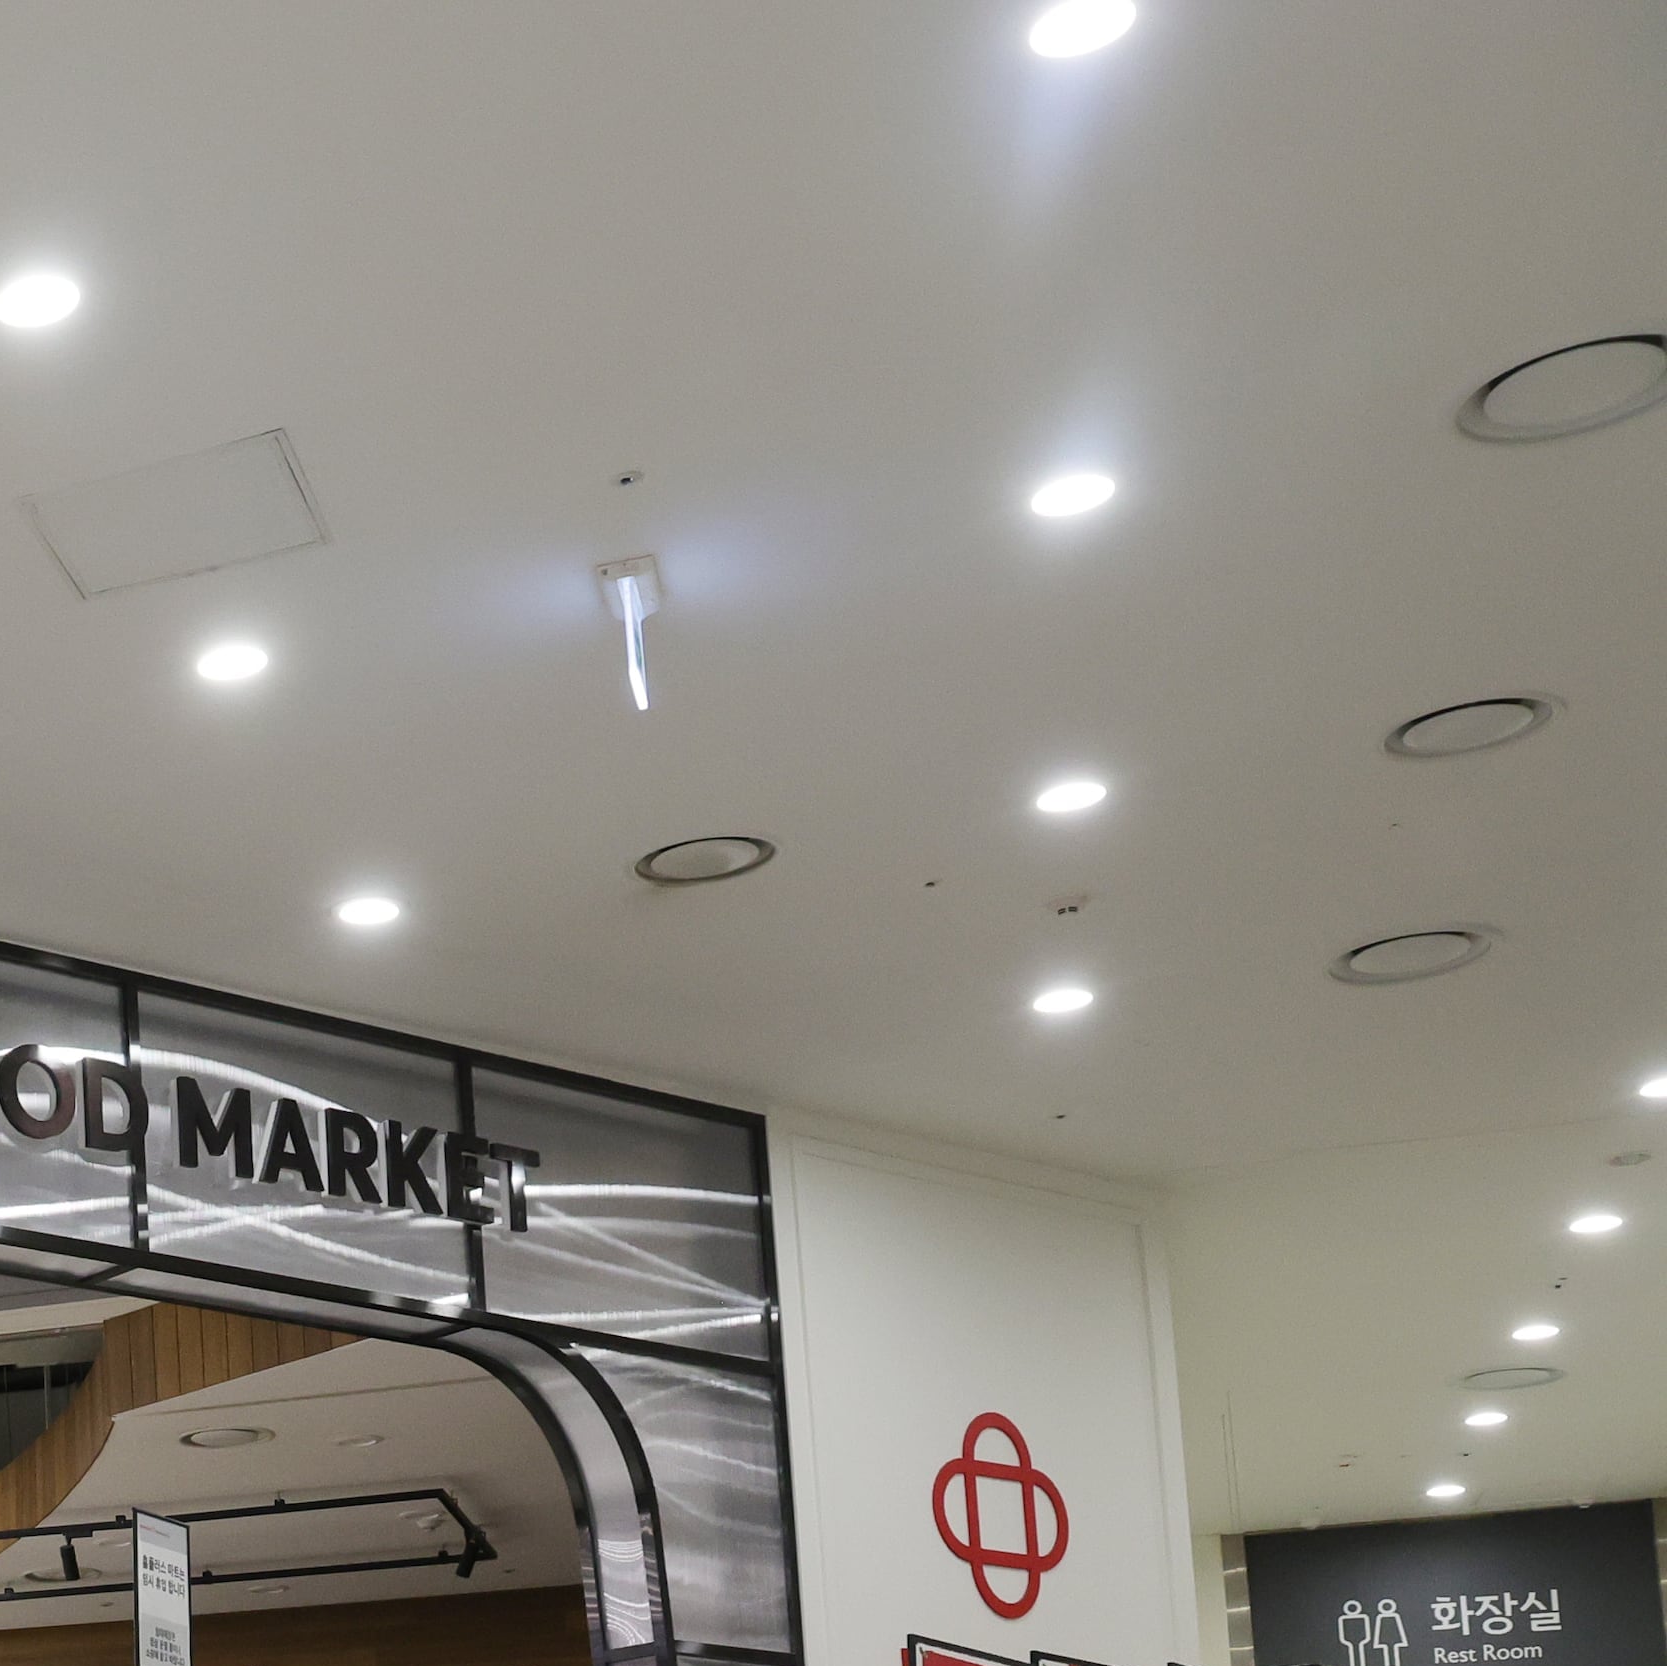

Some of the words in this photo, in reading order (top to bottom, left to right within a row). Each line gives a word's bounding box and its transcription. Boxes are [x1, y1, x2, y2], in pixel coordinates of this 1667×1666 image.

[170, 1075, 540, 1234] MARKET
[1430, 1588, 1562, 1636] 화장실
[1434, 1647, 1477, 1664] Rest
[1483, 1644, 1543, 1661] Room
